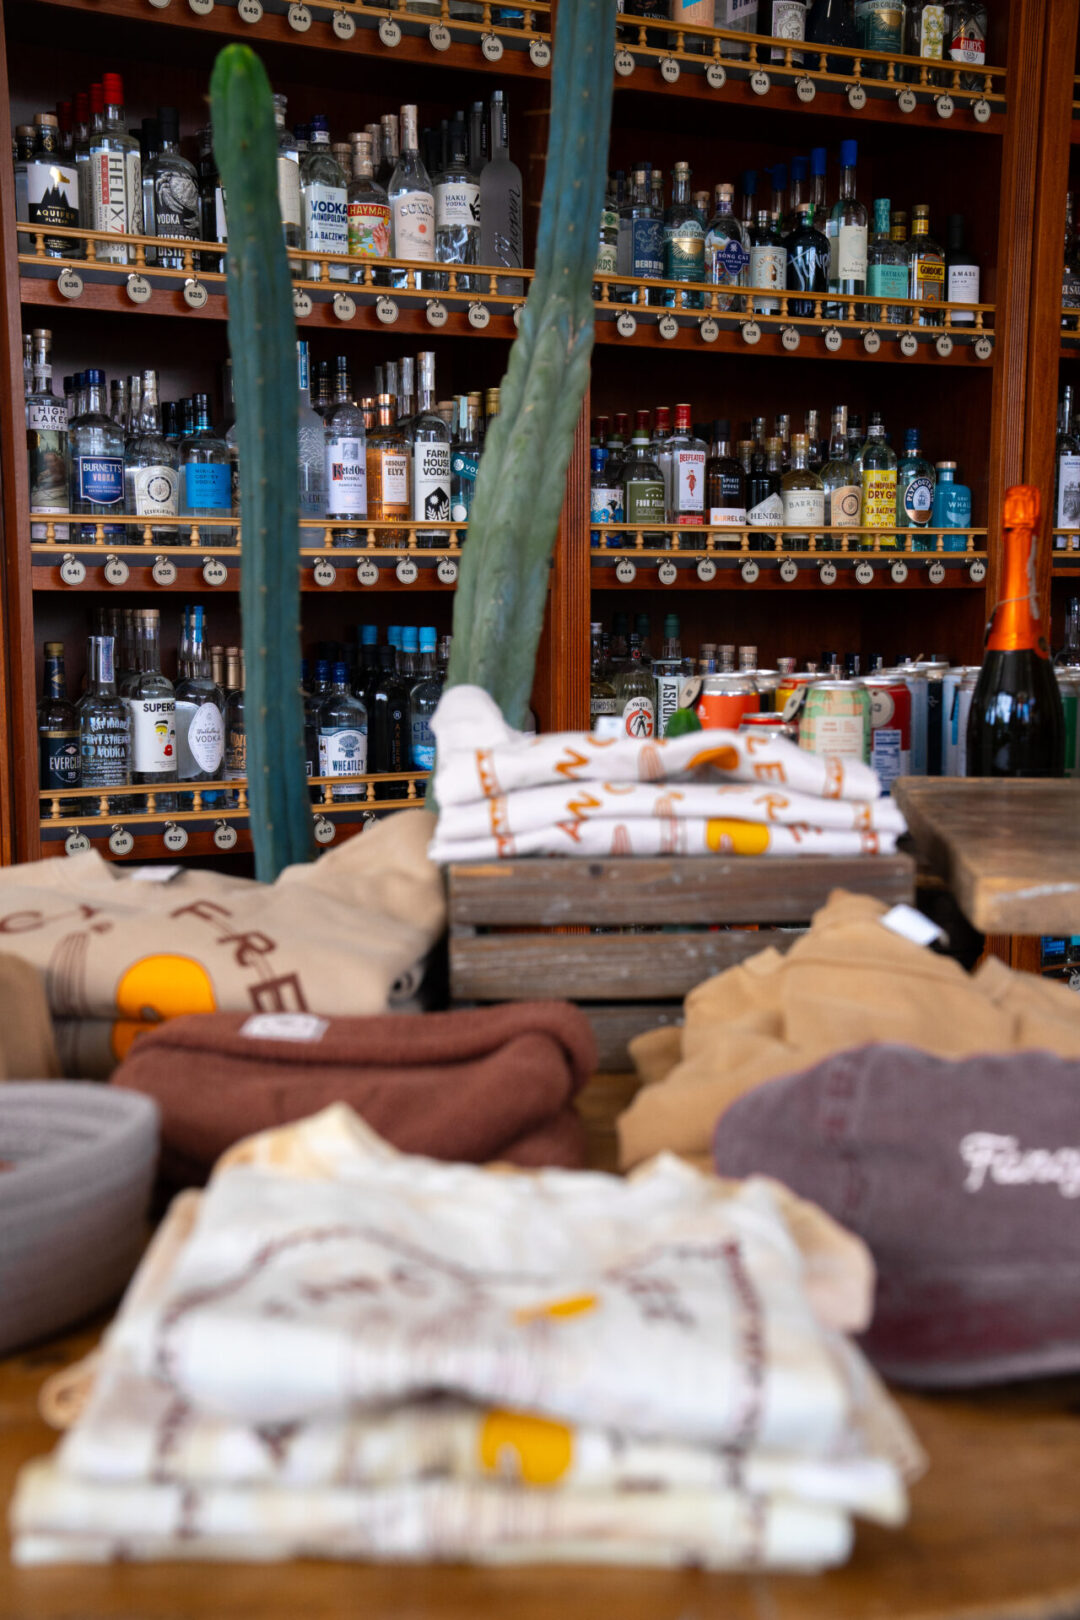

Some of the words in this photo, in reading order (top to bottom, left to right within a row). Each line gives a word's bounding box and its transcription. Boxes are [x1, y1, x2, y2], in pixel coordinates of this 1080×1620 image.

[157, 214, 180, 224] VODKA
[38, 407, 65, 415] HIGH
[33, 415, 68, 424] LAKES
[424, 458, 450, 467] HOUSE
[680, 454, 704, 463] BEEFEATER
[388, 468, 404, 476] ELYX
[93, 474, 115, 482] VODKA
[868, 490, 884, 499] DRY
[906, 478, 931, 502] PLYMOUTH
[195, 735, 221, 743] VODKA
[332, 760, 364, 770] WHEATLEY
